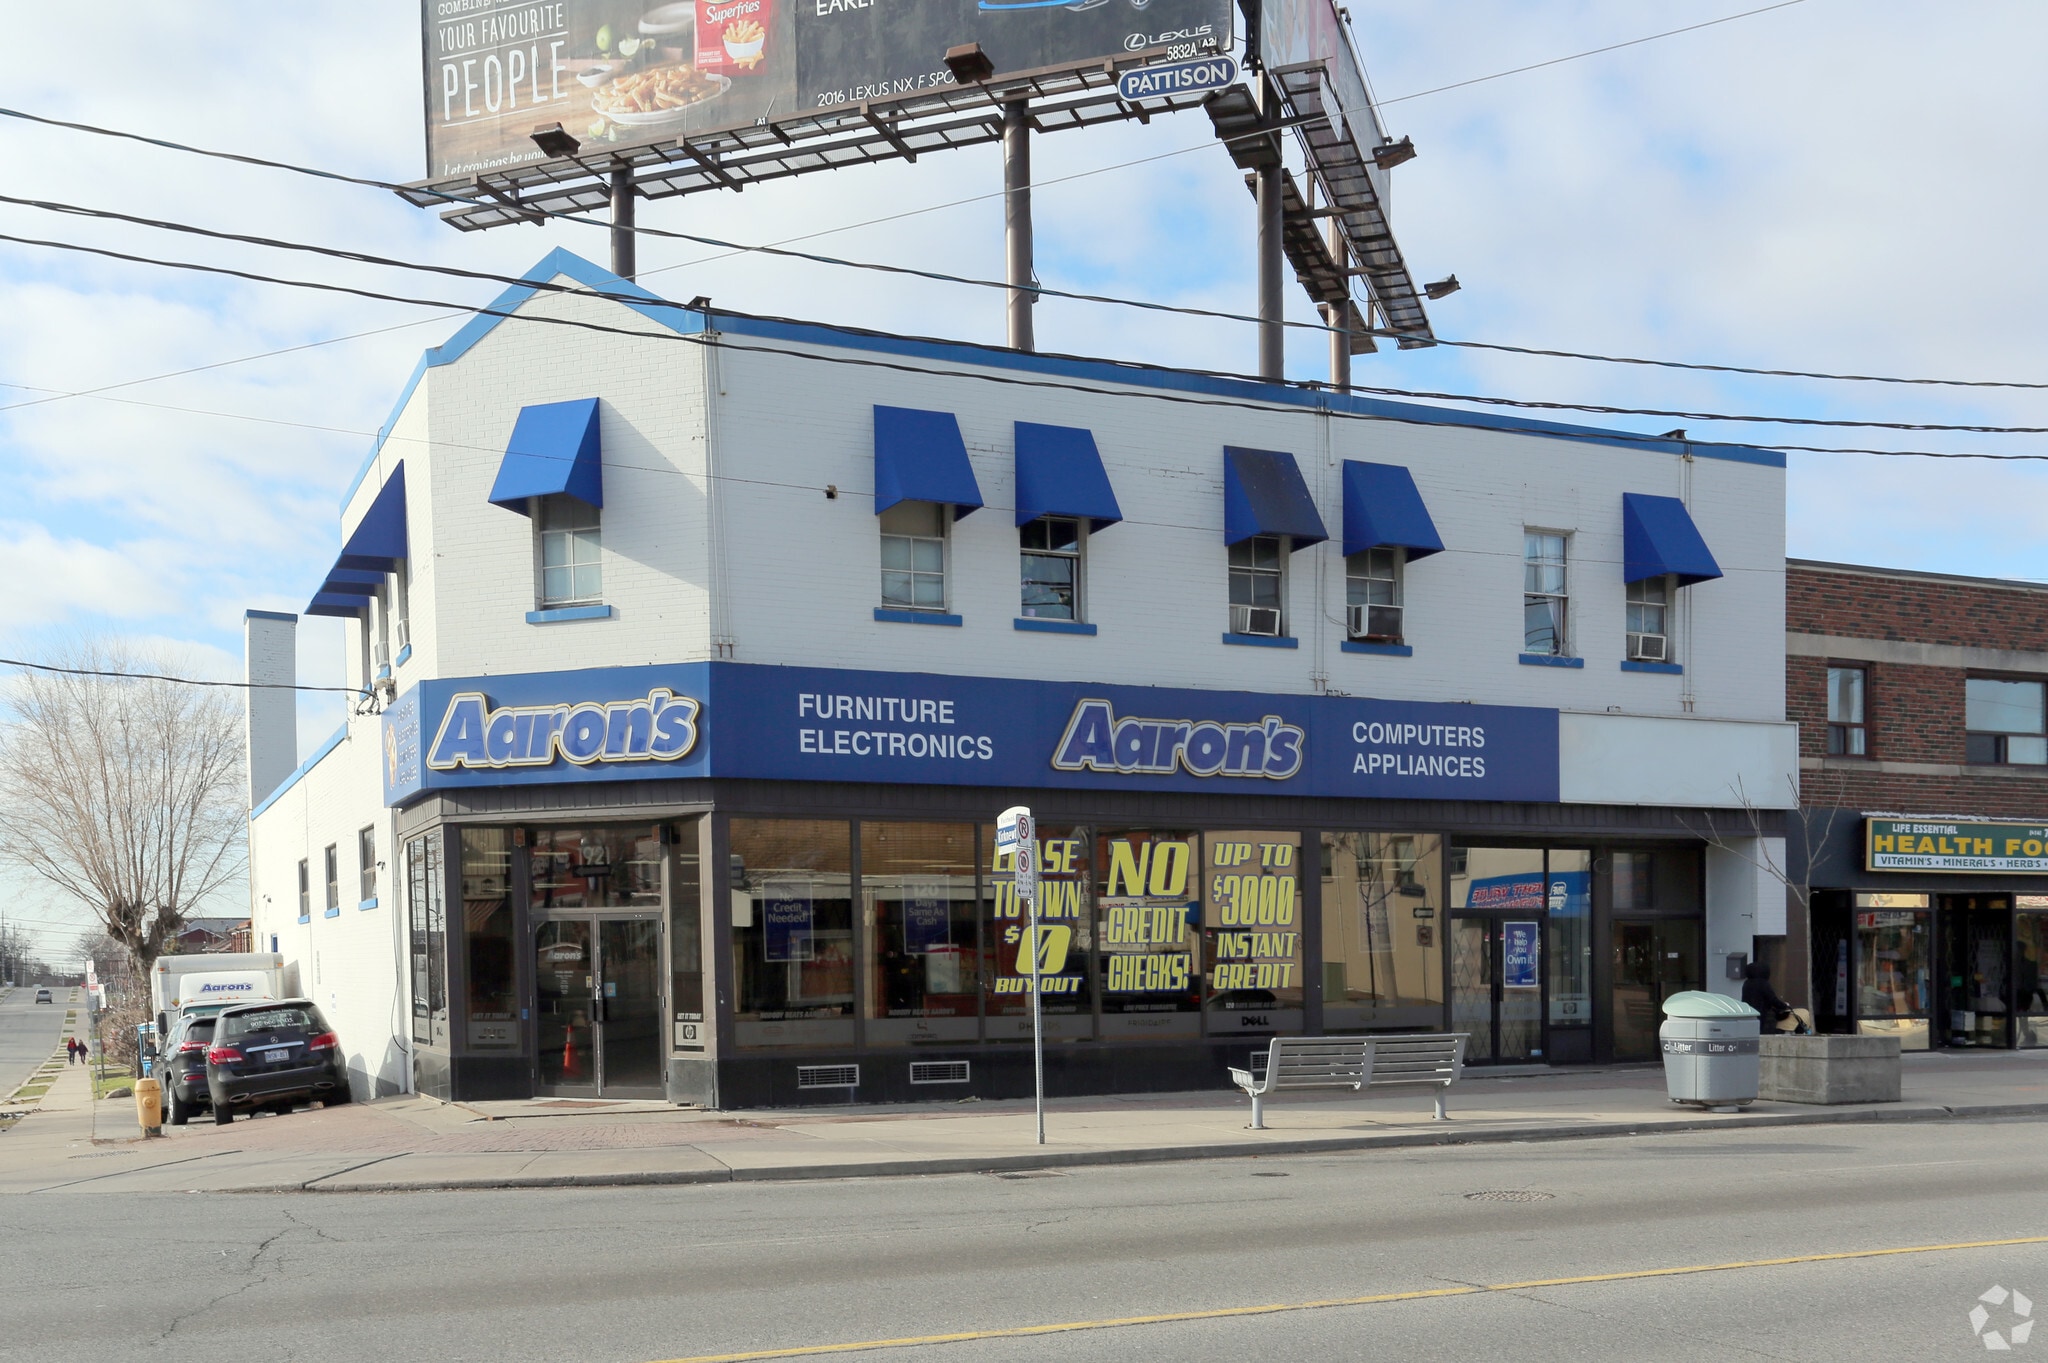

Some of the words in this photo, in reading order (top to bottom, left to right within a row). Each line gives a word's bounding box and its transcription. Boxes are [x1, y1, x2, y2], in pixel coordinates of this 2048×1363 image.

[705, 0, 760, 24] Superfries
[439, 22, 476, 52] YOUR
[481, 3, 563, 44] FAVOURITE
[1149, 24, 1212, 44] LEXUS
[1167, 42, 1197, 60] 5832A
[442, 40, 568, 120] PEOPLE
[817, 90, 846, 107] 2016
[849, 81, 889, 101] LEXUS
[894, 77, 914, 93] NX
[918, 74, 925, 89] F
[928, 69, 957, 88] SPO
[1128, 63, 1227, 94] PATTISON
[799, 693, 955, 725] FURNITURE
[430, 688, 699, 770] Aaron's
[1052, 699, 1304, 779] Aaron's
[1352, 720, 1485, 748] COMPUTERS
[799, 730, 994, 760] ELECTRONICS
[1352, 752, 1486, 778] APPLIANCES
[1892, 823, 1911, 834] LIFE
[1913, 824, 1958, 835] ESSENTIAL
[1214, 843, 1252, 866] UP
[1259, 843, 1293, 866] TO
[1874, 835, 1993, 855] HEALTH
[2005, 839, 2048, 857] FO
[1107, 841, 1190, 896] NO
[1881, 856, 1932, 866] VITAMIN'S
[1943, 858, 1996, 868] MINERAL'S
[2007, 859, 2041, 868] HERB'S
[773, 903, 802, 912] Credit
[779, 893, 794, 902] No
[1213, 875, 1295, 925] $3000
[909, 908, 932, 917] Same
[917, 917, 937, 926] Cash
[1107, 907, 1190, 943] CREDIT
[1515, 930, 1526, 938] We
[1004, 924, 1071, 974] $0
[1216, 933, 1297, 958] INSTANT
[1514, 938, 1527, 947] help
[1515, 946, 1527, 954] you
[1507, 954, 1527, 964] Own
[1108, 954, 1190, 991] CHECKS!
[1213, 963, 1295, 989] CREDIT
[994, 977, 1035, 993] BUY
[1040, 977, 1083, 993] OUT
[1241, 1015, 1269, 1026] DELL
[1674, 1042, 1692, 1052] Litter
[1708, 1043, 1725, 1052] Litter
